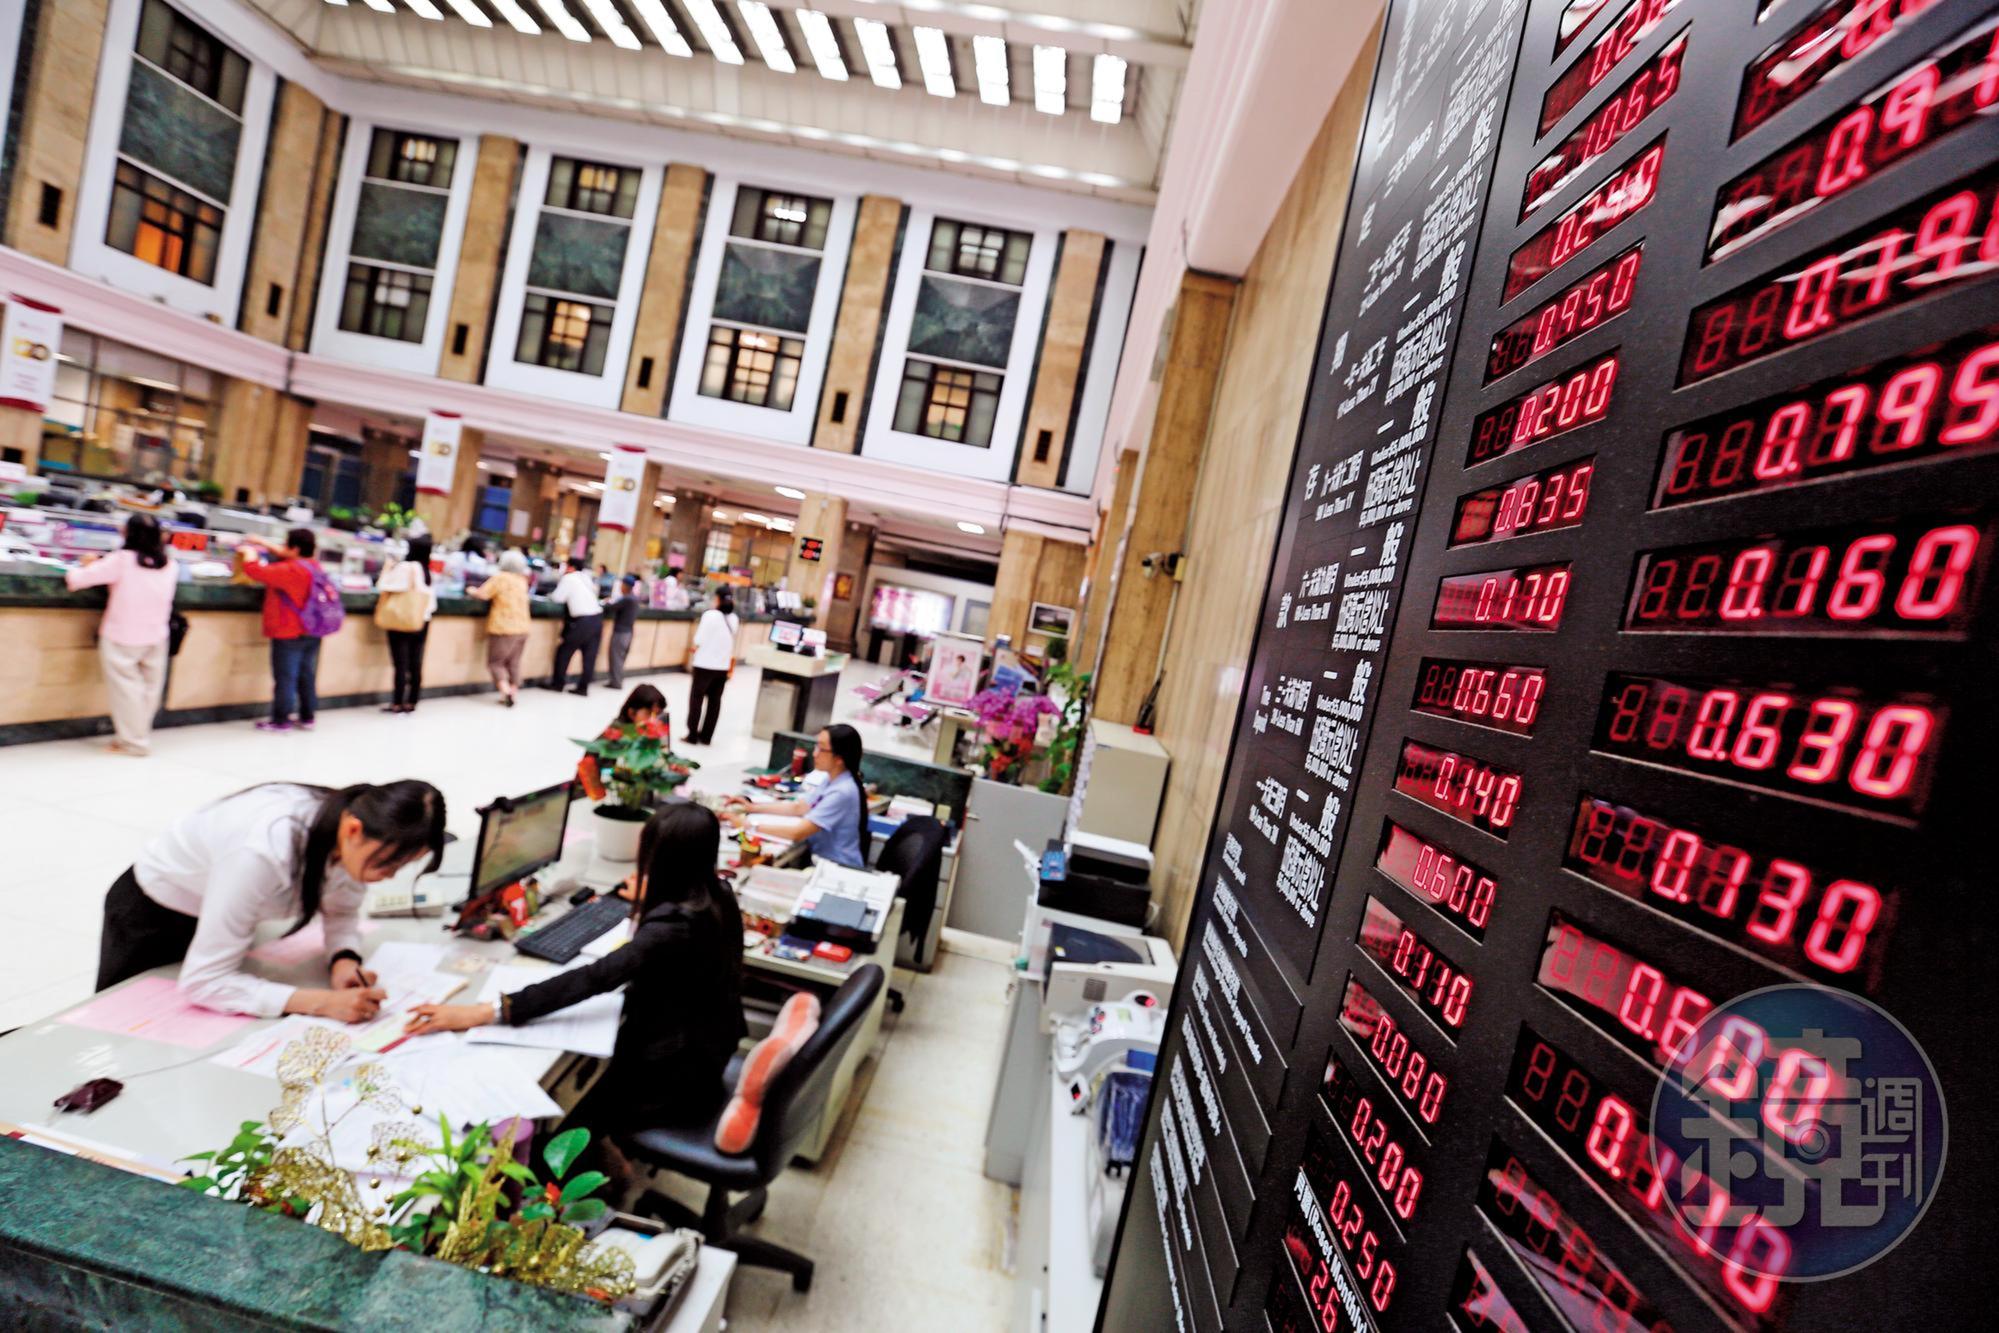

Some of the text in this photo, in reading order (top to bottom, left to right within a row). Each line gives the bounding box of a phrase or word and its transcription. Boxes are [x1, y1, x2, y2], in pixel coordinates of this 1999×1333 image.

[1533, 252, 1640, 354] 0.950
[1514, 359, 1616, 442] 0.200
[1754, 340, 1999, 480] 0.795
[1494, 466, 1592, 532] 0.835
[1474, 571, 1569, 621] 0.170
[1719, 526, 1981, 620] 0.160
[1453, 668, 1544, 724] 0.660
[1686, 689, 1935, 799] 0.630
[1434, 756, 1520, 827] 0.140
[1413, 844, 1497, 927] 0.600
[1650, 828, 1882, 974] 0.130
[1393, 929, 1472, 1026] 0.110
[1371, 1015, 1447, 1123] 0.080
[1619, 963, 1833, 1145] 0.600
[1351, 1097, 1421, 1219] 0.200
[1331, 1180, 1396, 1312] 0.250
